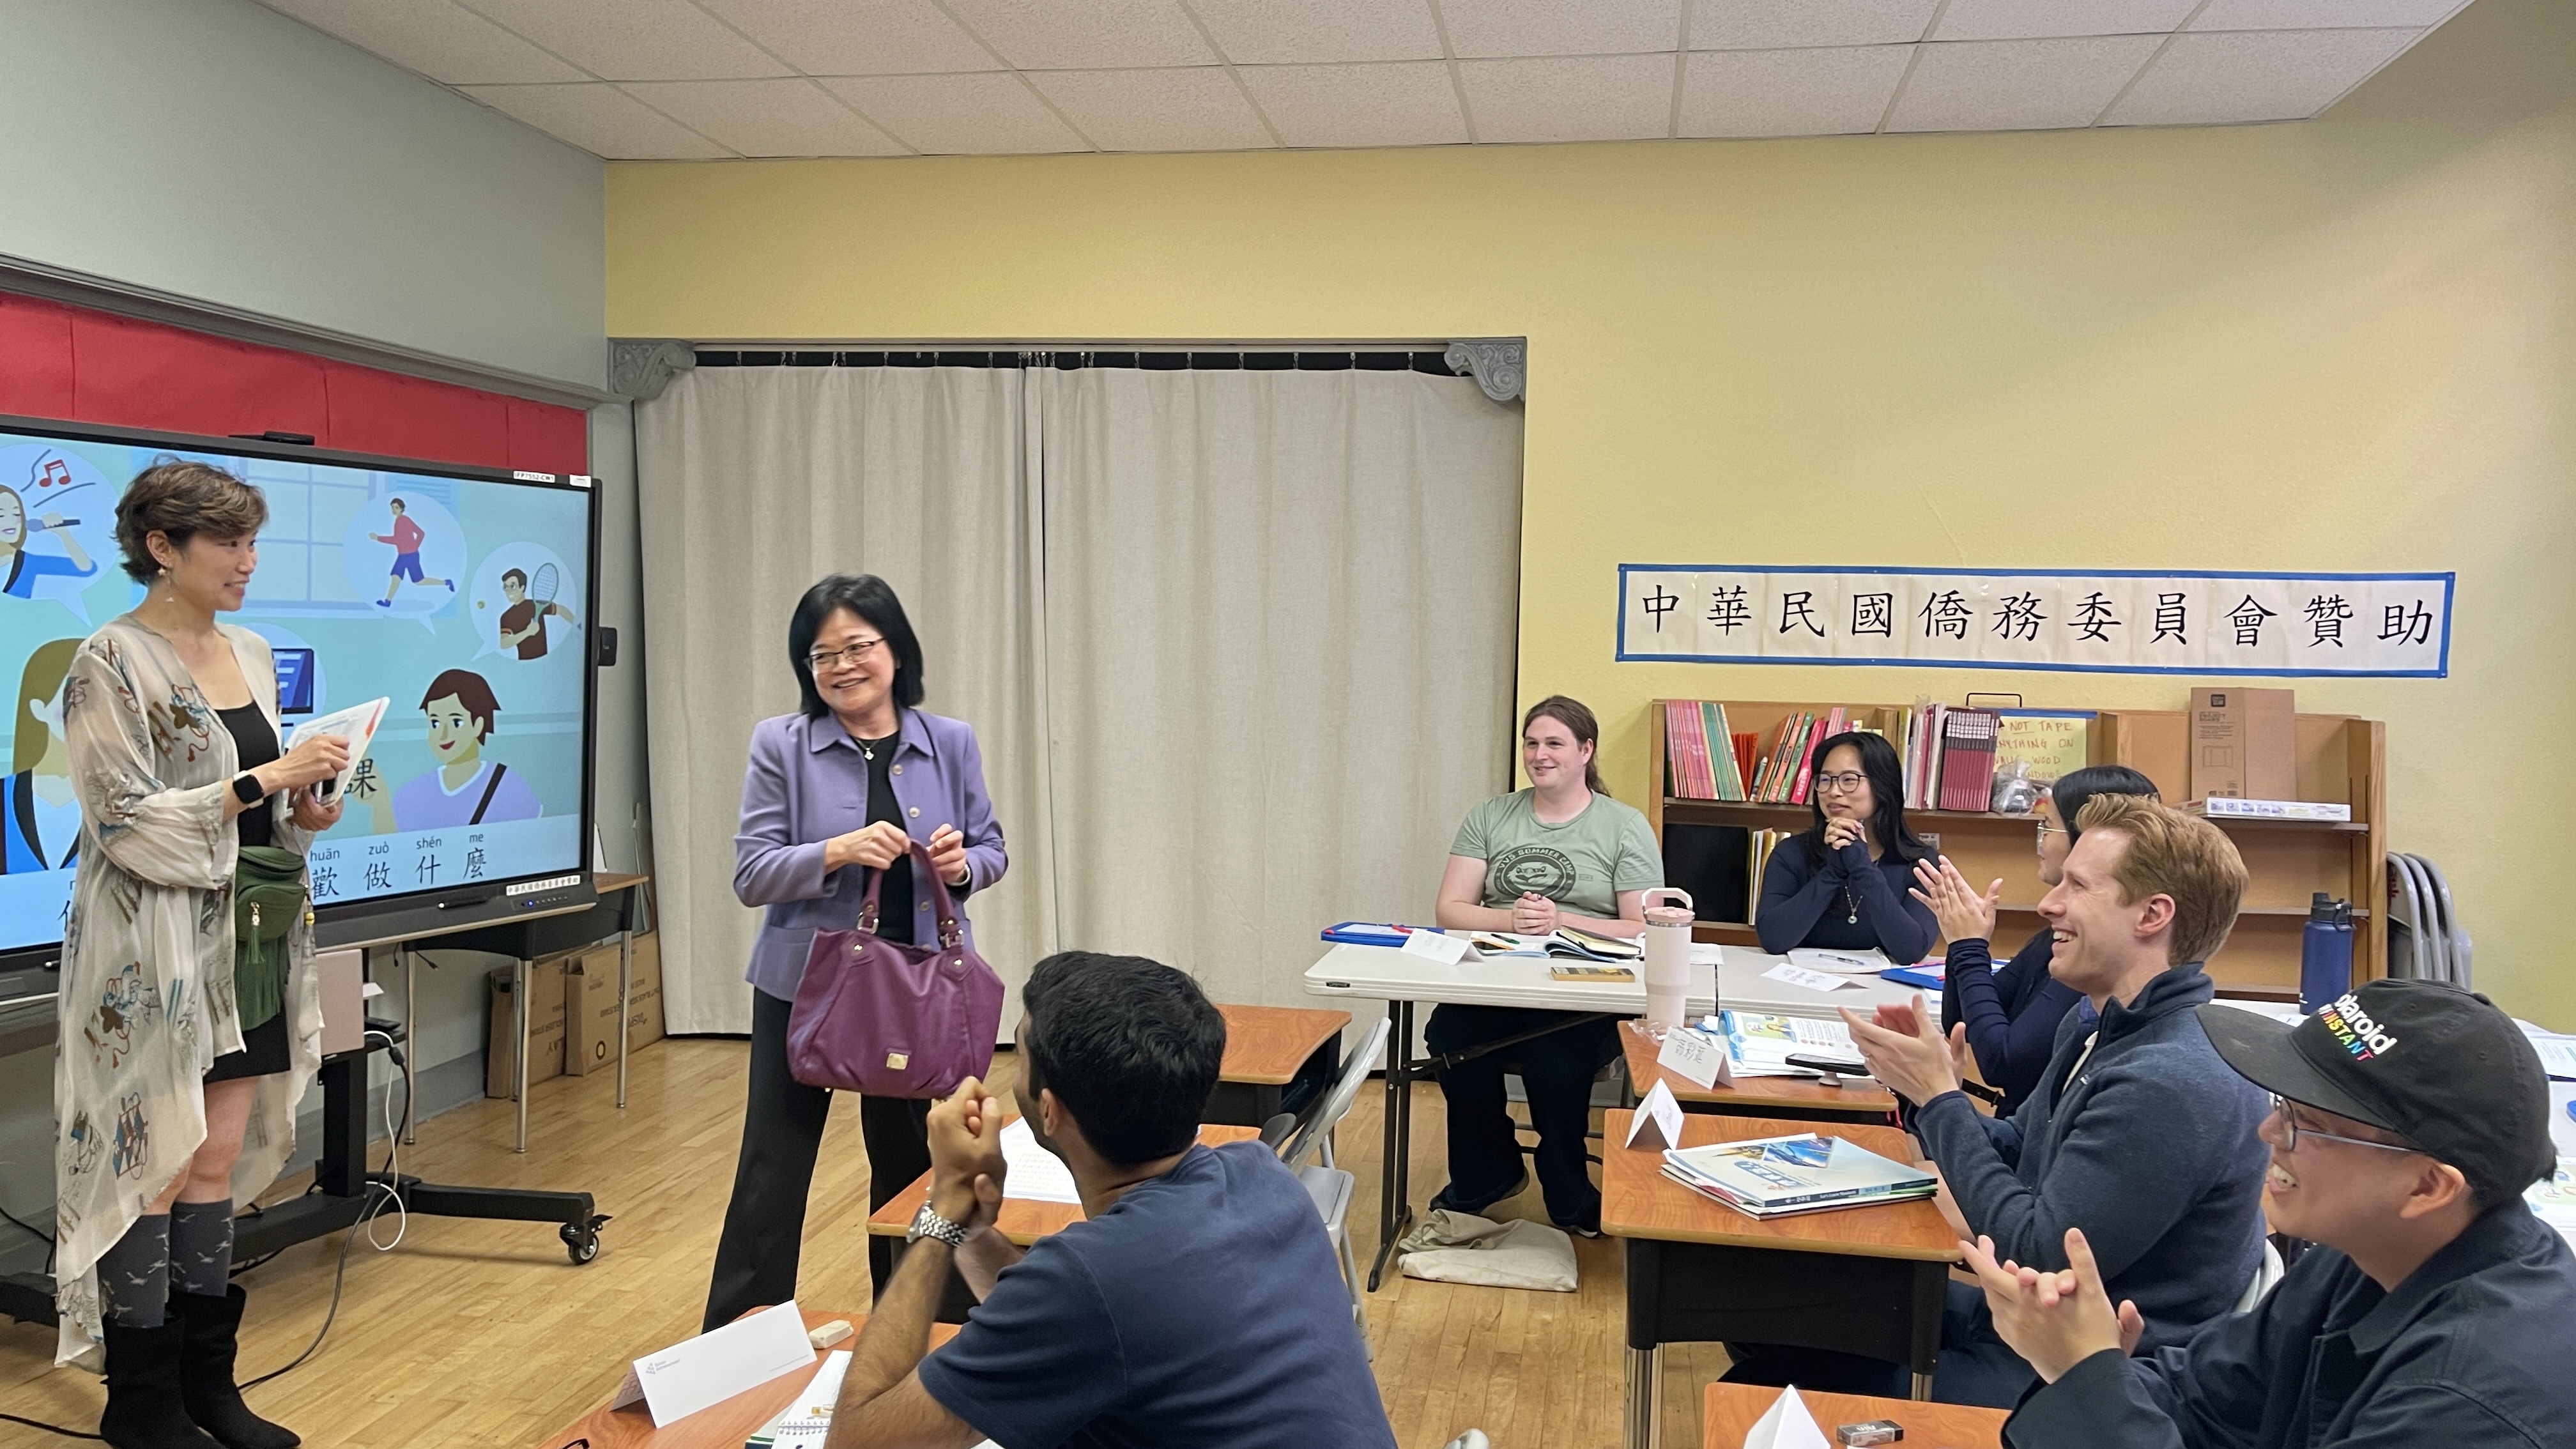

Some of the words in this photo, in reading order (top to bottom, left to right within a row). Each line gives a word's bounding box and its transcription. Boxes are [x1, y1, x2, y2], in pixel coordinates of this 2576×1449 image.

[1642, 584, 2434, 648] 中華民國僑務委員會贊助
[2010, 721, 2029, 732] NOT
[2038, 721, 2073, 733] TAPE
[2058, 738, 2074, 747] ON
[2033, 756, 2061, 765] WOOD
[310, 848, 340, 862] huān
[369, 841, 389, 855] zuò
[416, 836, 442, 850] shén
[469, 833, 484, 843] me
[2334, 993, 2398, 1055] olaroid
